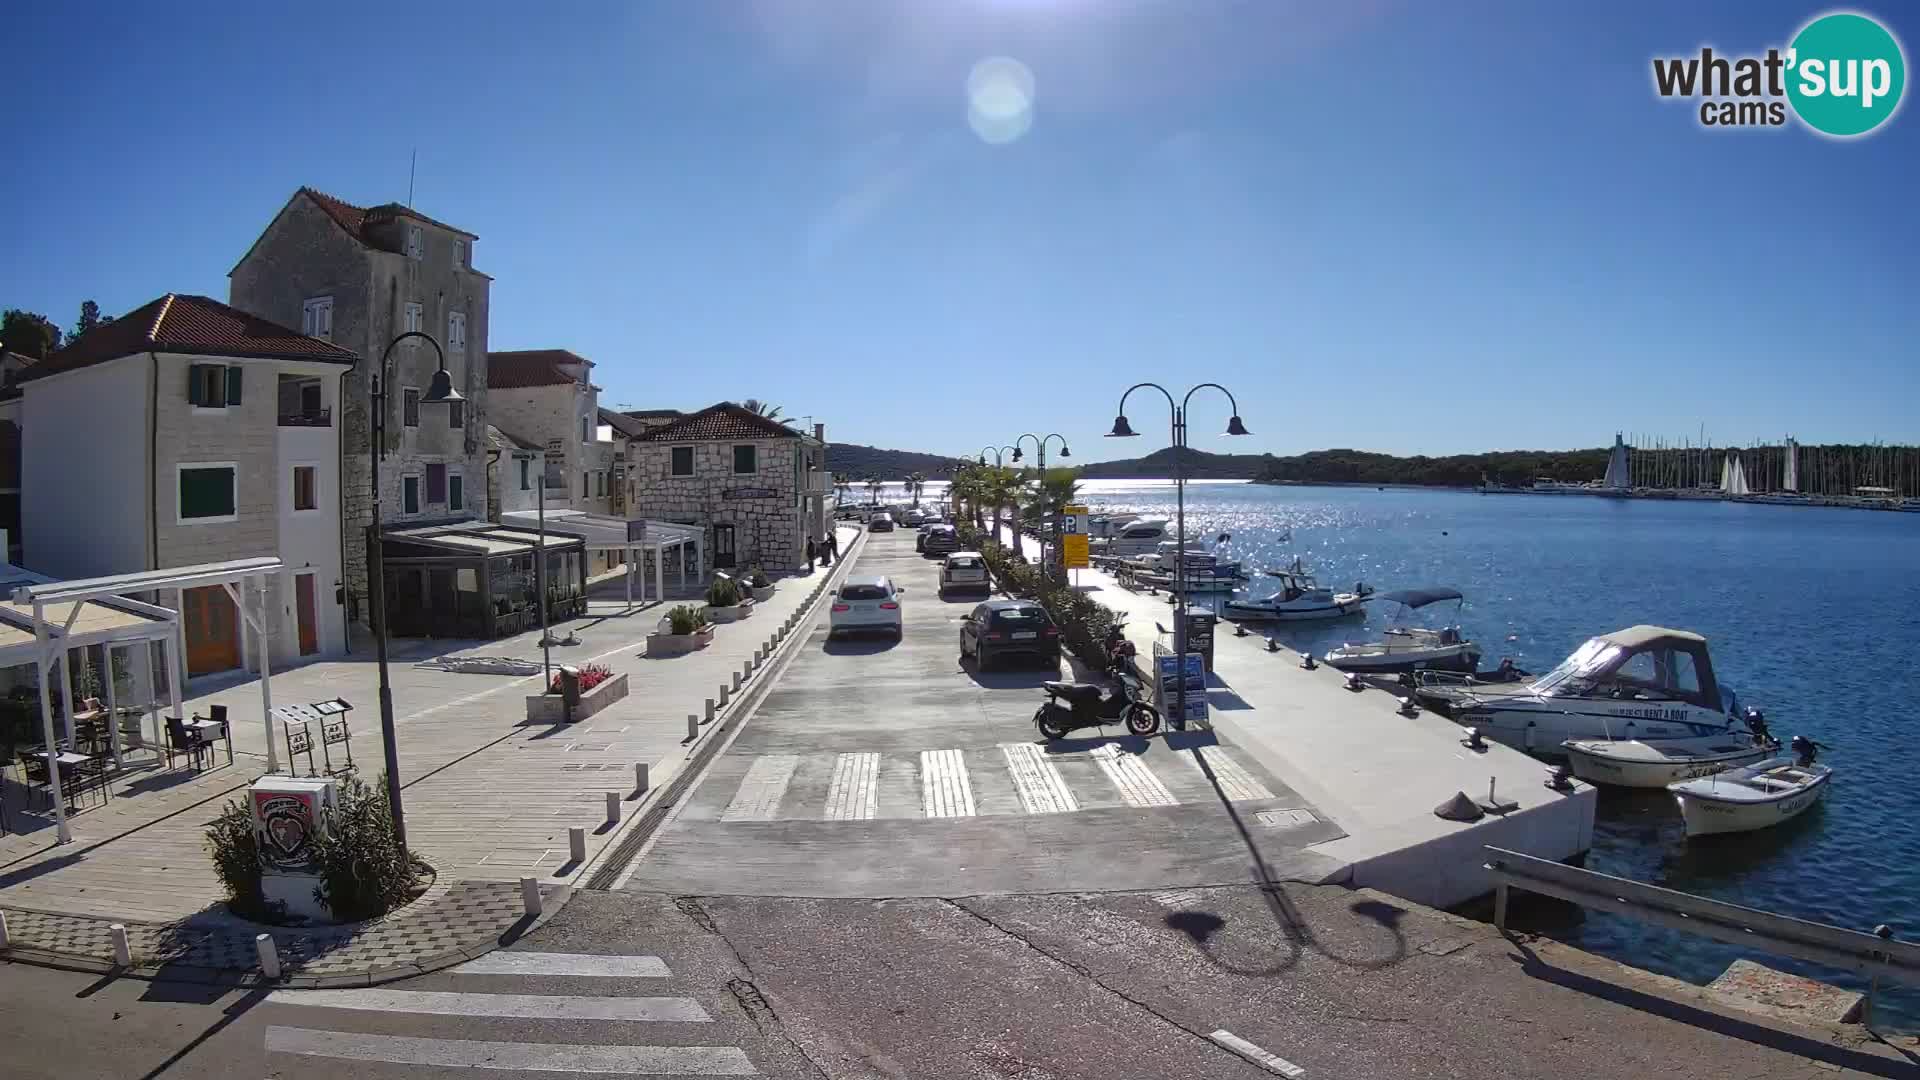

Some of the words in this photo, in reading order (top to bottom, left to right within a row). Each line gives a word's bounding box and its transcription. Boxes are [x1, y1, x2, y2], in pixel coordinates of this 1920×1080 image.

[1066, 516, 1075, 532] P
[1643, 708, 1663, 720] RENT
[1671, 709, 1688, 721] BOAT
